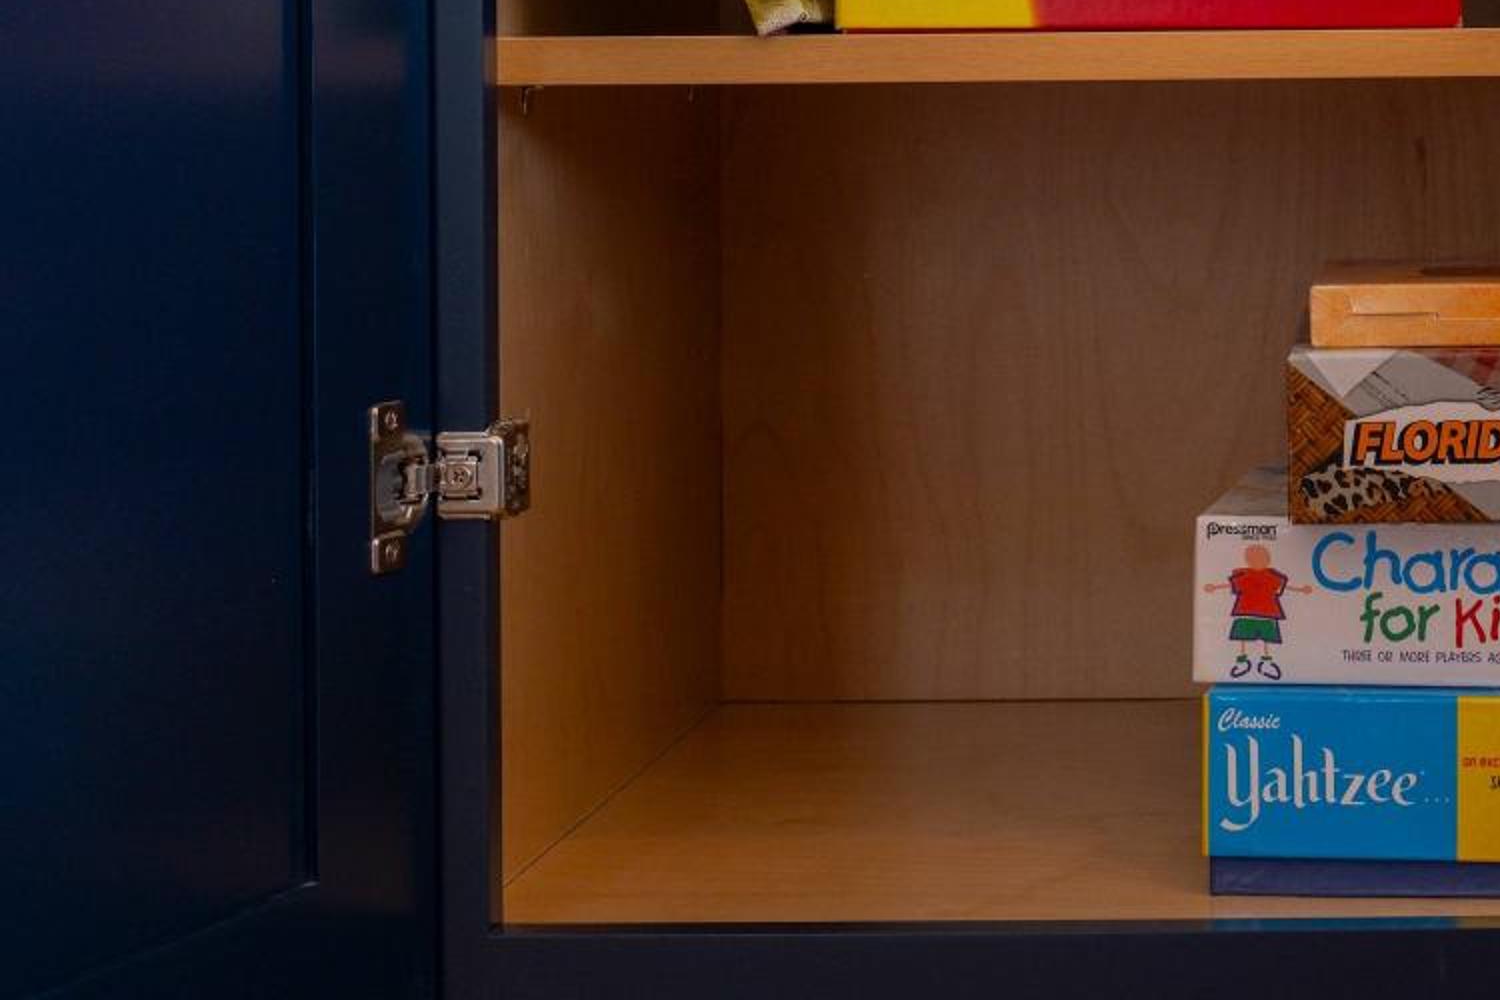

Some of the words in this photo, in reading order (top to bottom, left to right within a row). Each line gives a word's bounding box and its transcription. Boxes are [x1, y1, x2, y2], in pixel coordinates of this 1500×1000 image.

[1360, 590, 1441, 643] for
[1342, 649, 1372, 663] THREE
[1377, 650, 1393, 663] OR
[1399, 650, 1431, 664] MORE
[1435, 650, 1483, 664] PLAYERS
[1217, 706, 1281, 732] Classic
[1463, 757, 1477, 768] an
[1218, 732, 1421, 833] Yahtzee
